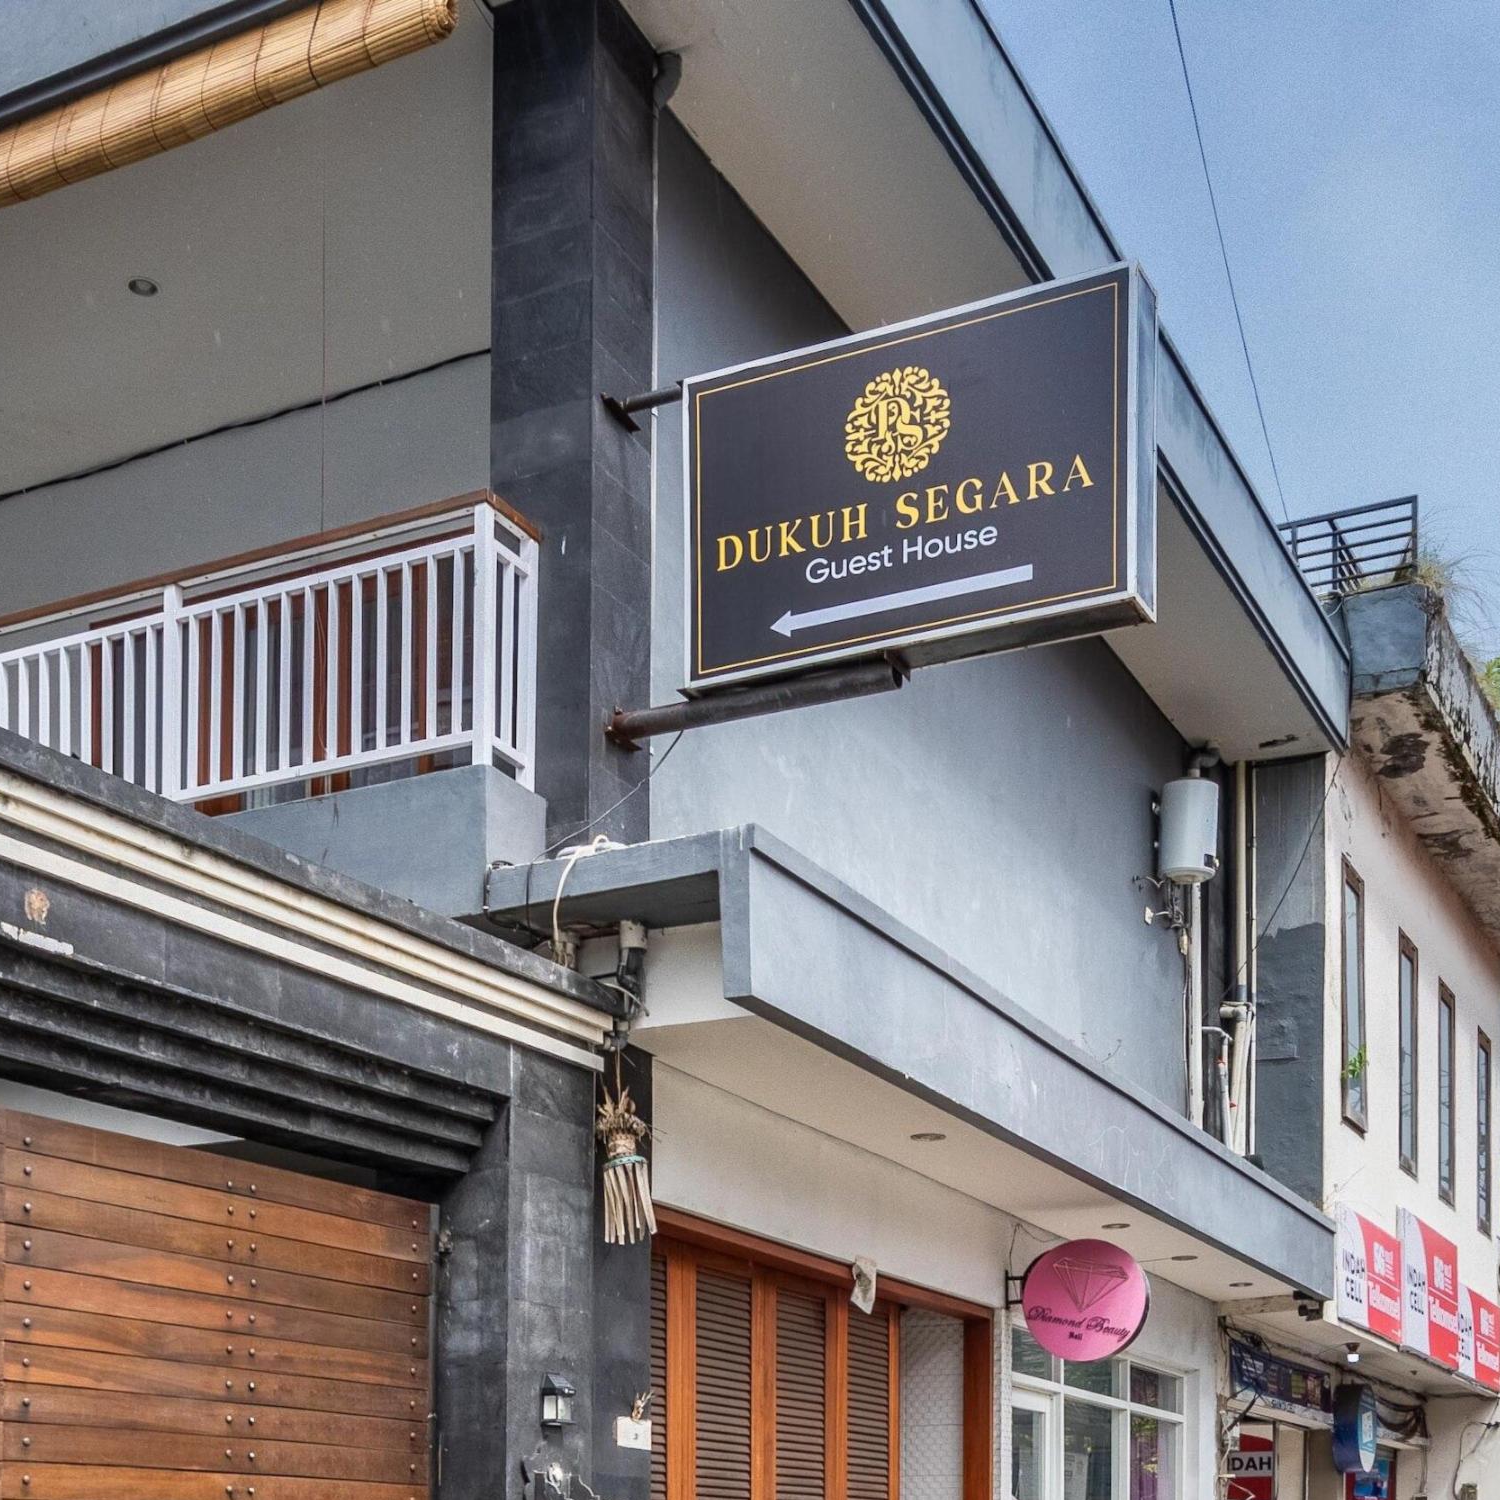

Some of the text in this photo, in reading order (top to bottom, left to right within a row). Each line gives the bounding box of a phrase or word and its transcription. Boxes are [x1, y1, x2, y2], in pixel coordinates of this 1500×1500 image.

[716, 453, 1095, 573] DUKUH SEGARA
[805, 524, 999, 584] Guest House
[1342, 1248, 1365, 1279] INDAH
[1345, 1276, 1363, 1304] CELL
[1410, 1290, 1425, 1315] CELL
[1027, 1306, 1131, 1342] Diamond Beauty
